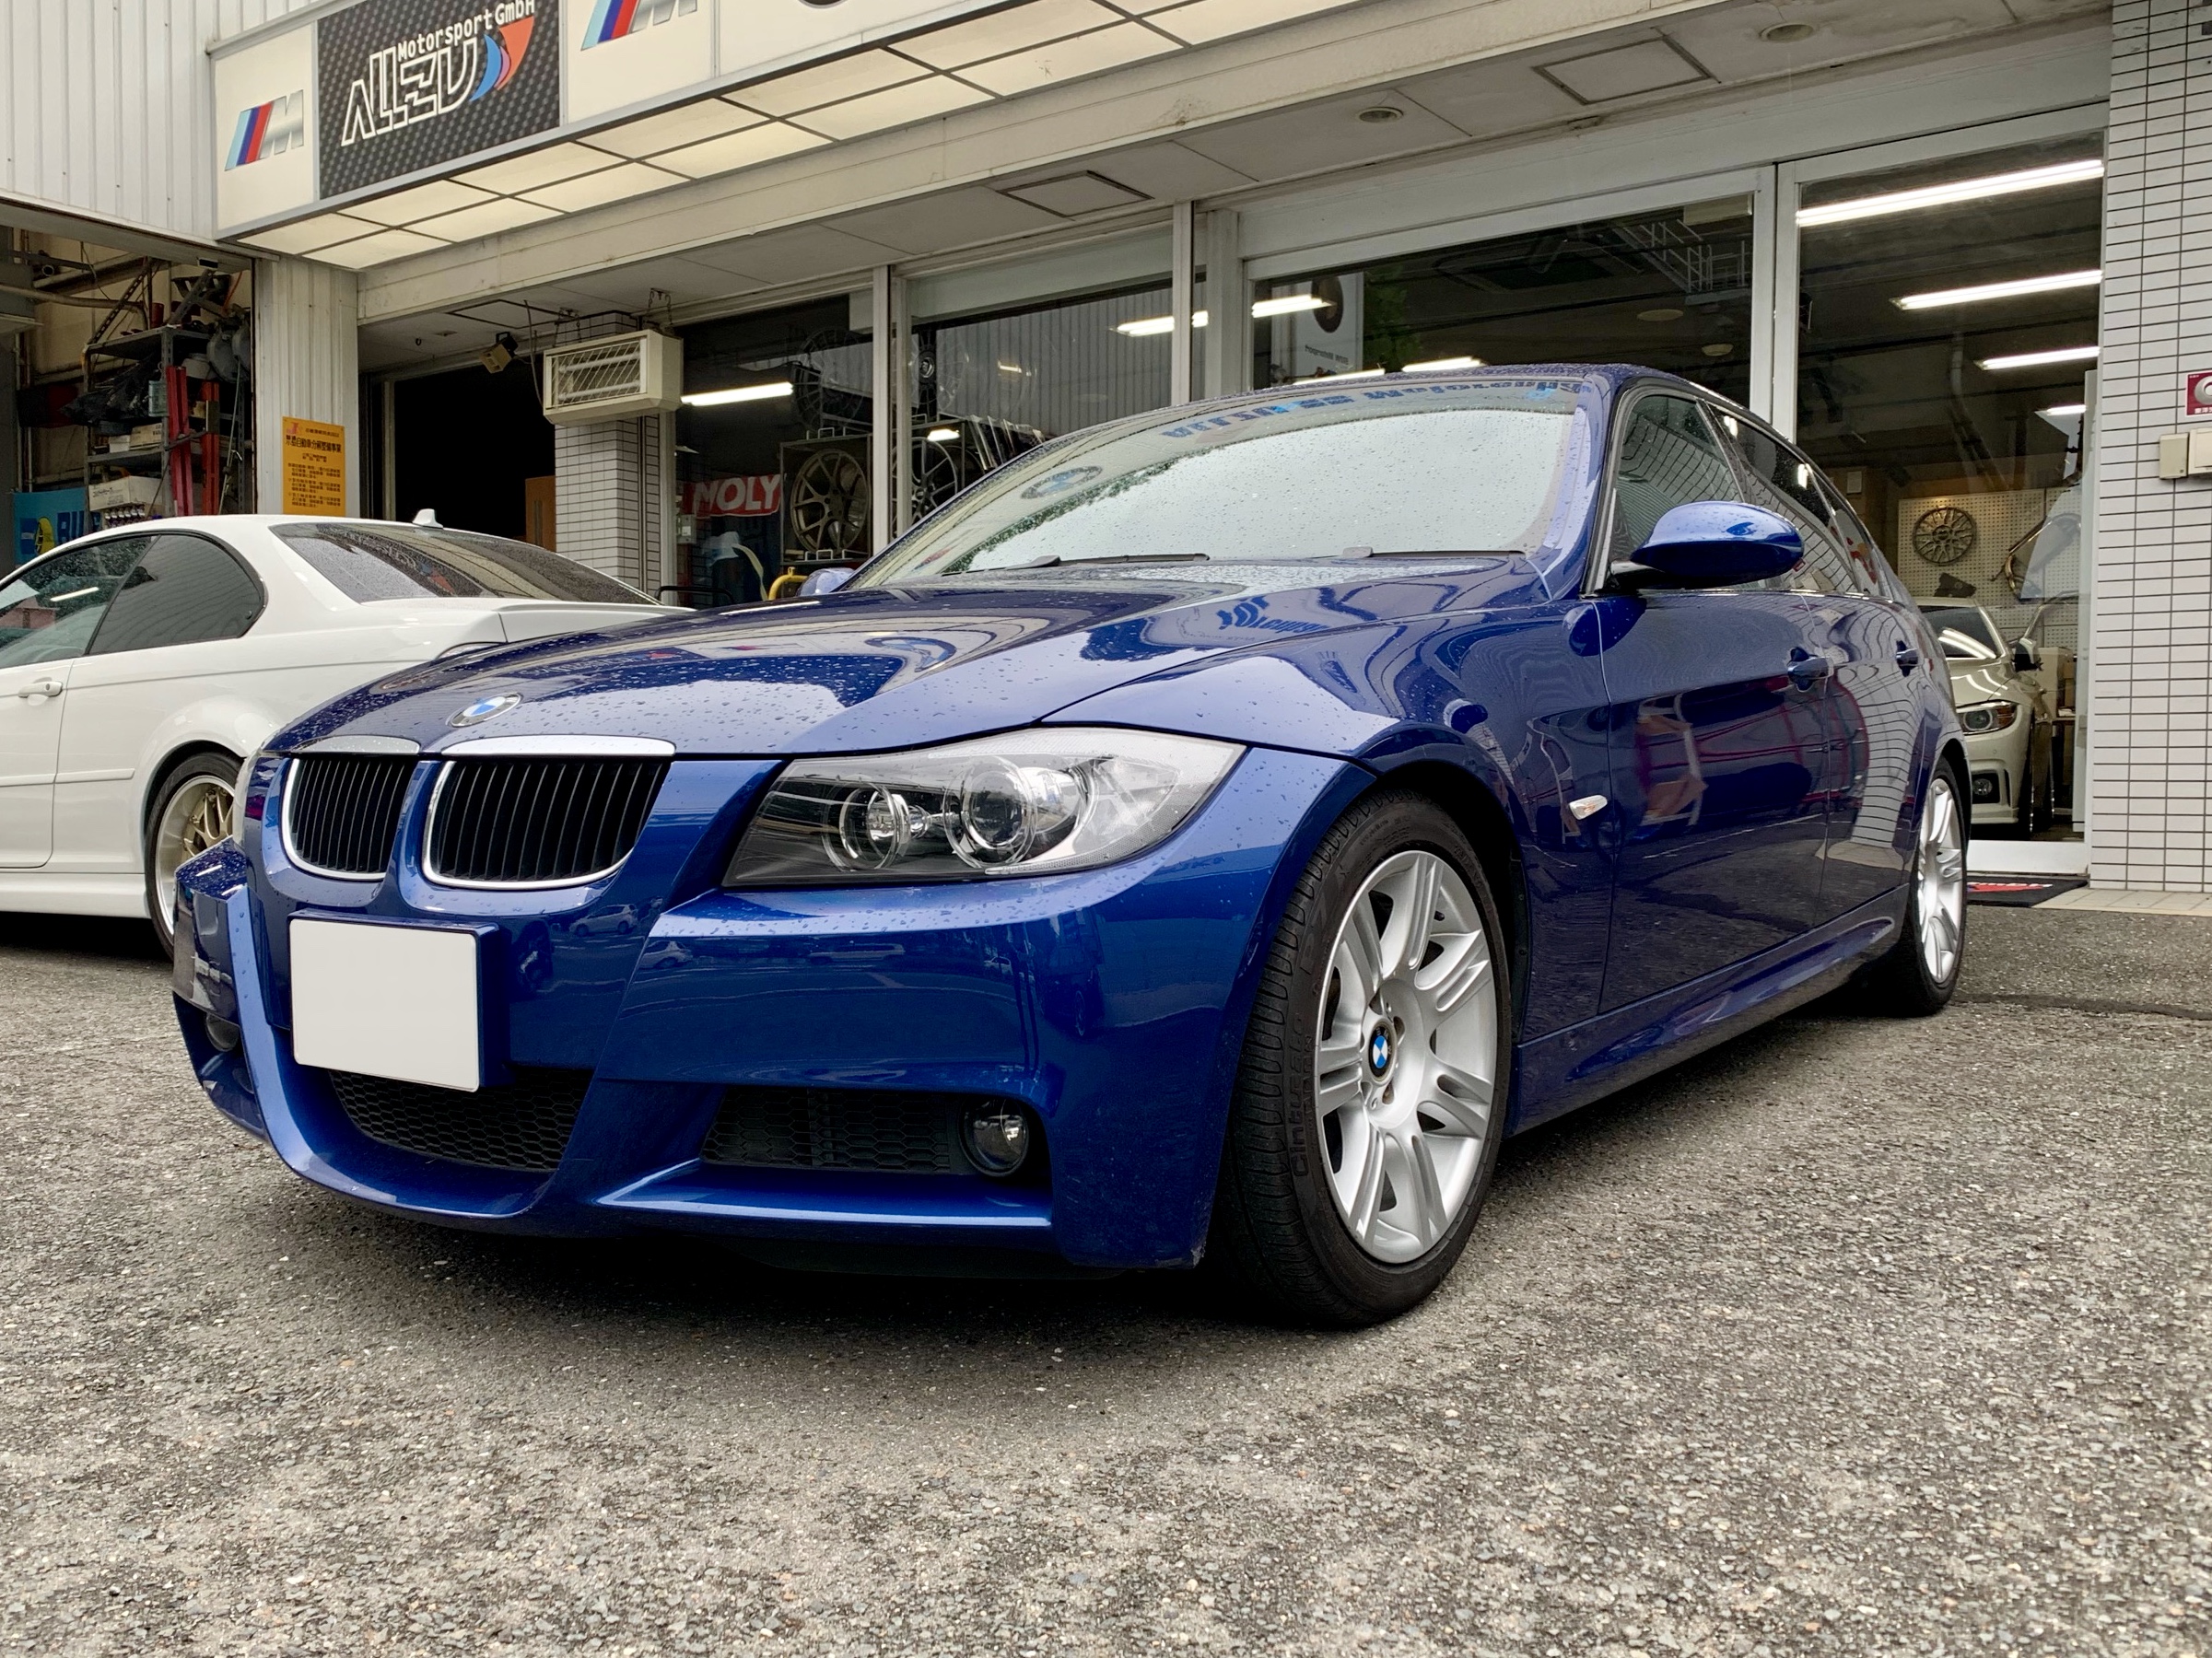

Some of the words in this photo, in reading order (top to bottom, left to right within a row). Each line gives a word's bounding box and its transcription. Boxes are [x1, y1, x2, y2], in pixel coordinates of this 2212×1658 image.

[397, 9, 493, 62] Motorsport
[495, 0, 535, 26] GmbH
[693, 474, 781, 513] MOLY
